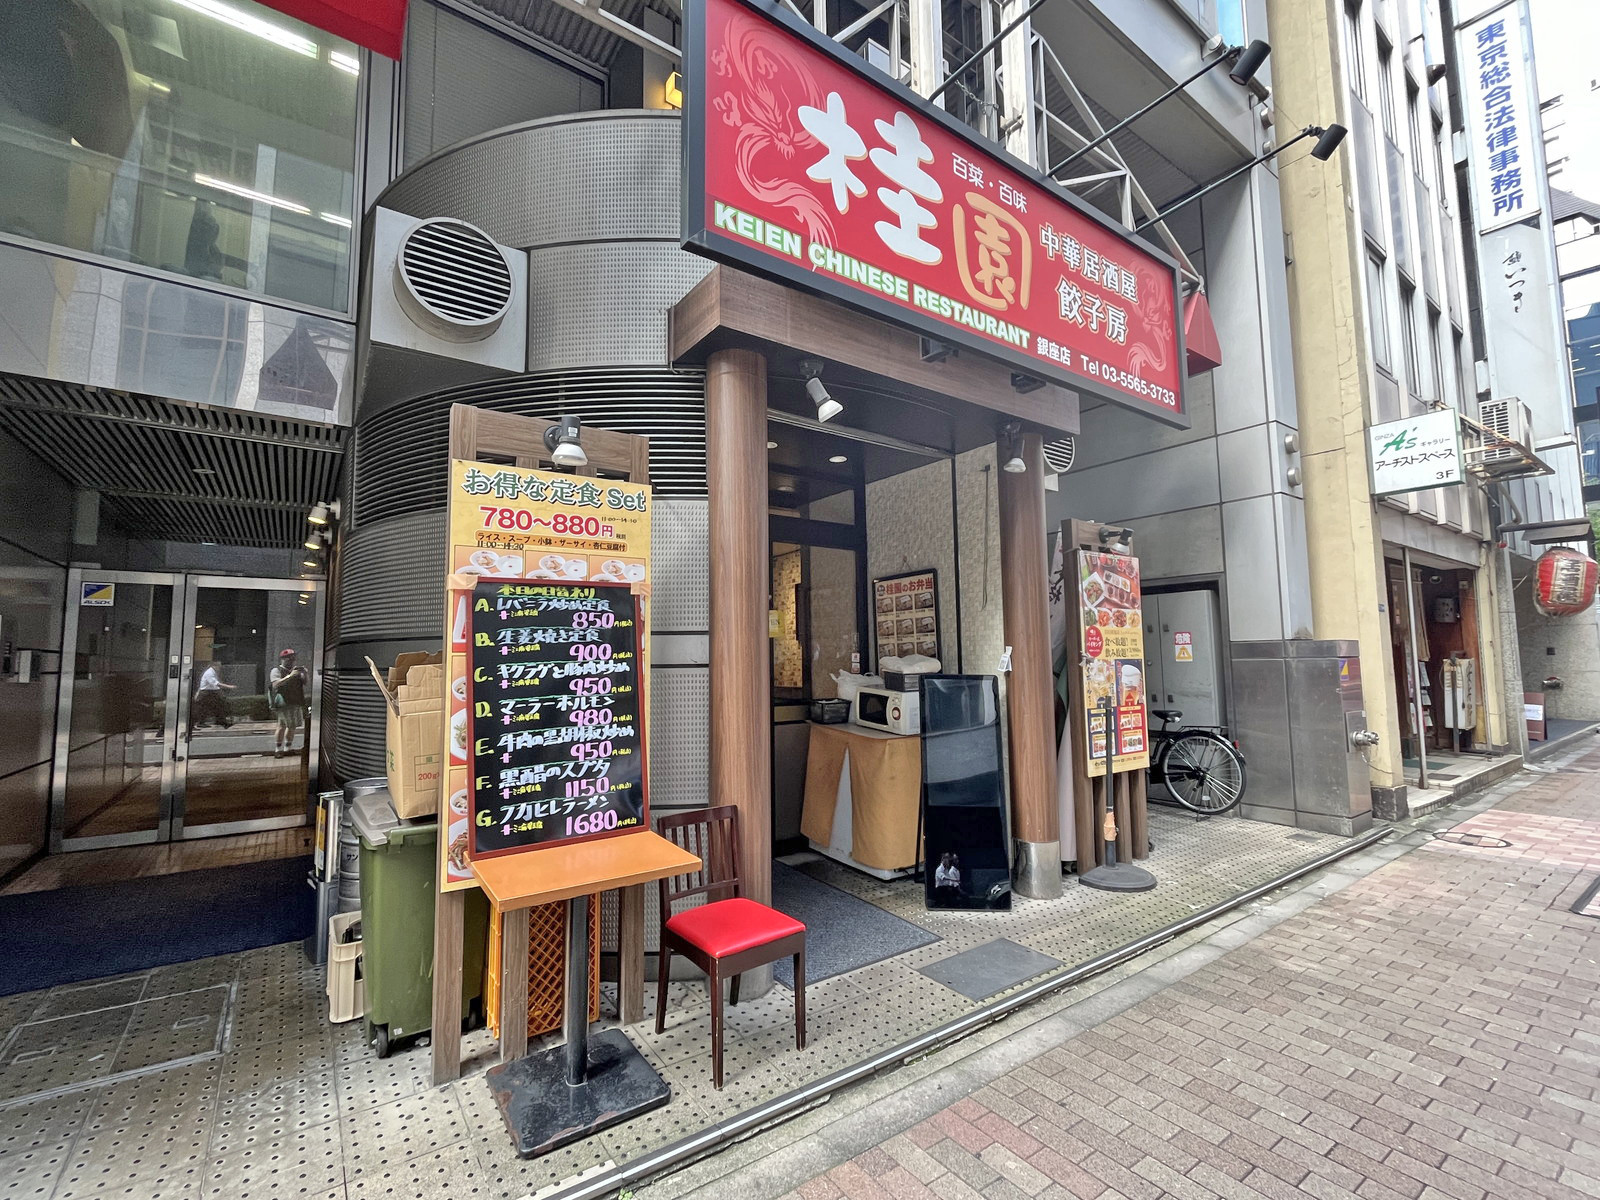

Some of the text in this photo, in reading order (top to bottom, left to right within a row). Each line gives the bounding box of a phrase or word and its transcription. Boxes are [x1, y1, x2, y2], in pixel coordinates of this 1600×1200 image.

[1475, 18, 1523, 217] 東京総合法律事務所
[952, 152, 1028, 214] 百菜・百味
[714, 200, 1031, 350] KEIEN CHINESE RESTAURANT
[1039, 223, 1138, 303] 中華居酒屋
[1055, 277, 1128, 345] 餃子房
[1036, 336, 1176, 407] 銀座店 Tel 03-5565-3733
[463, 468, 647, 512] お得な定食 Set
[1375, 448, 1456, 471] アーチストスペース
[1436, 469, 1454, 480] 3F
[500, 795, 610, 825] フカヒレラーメン
